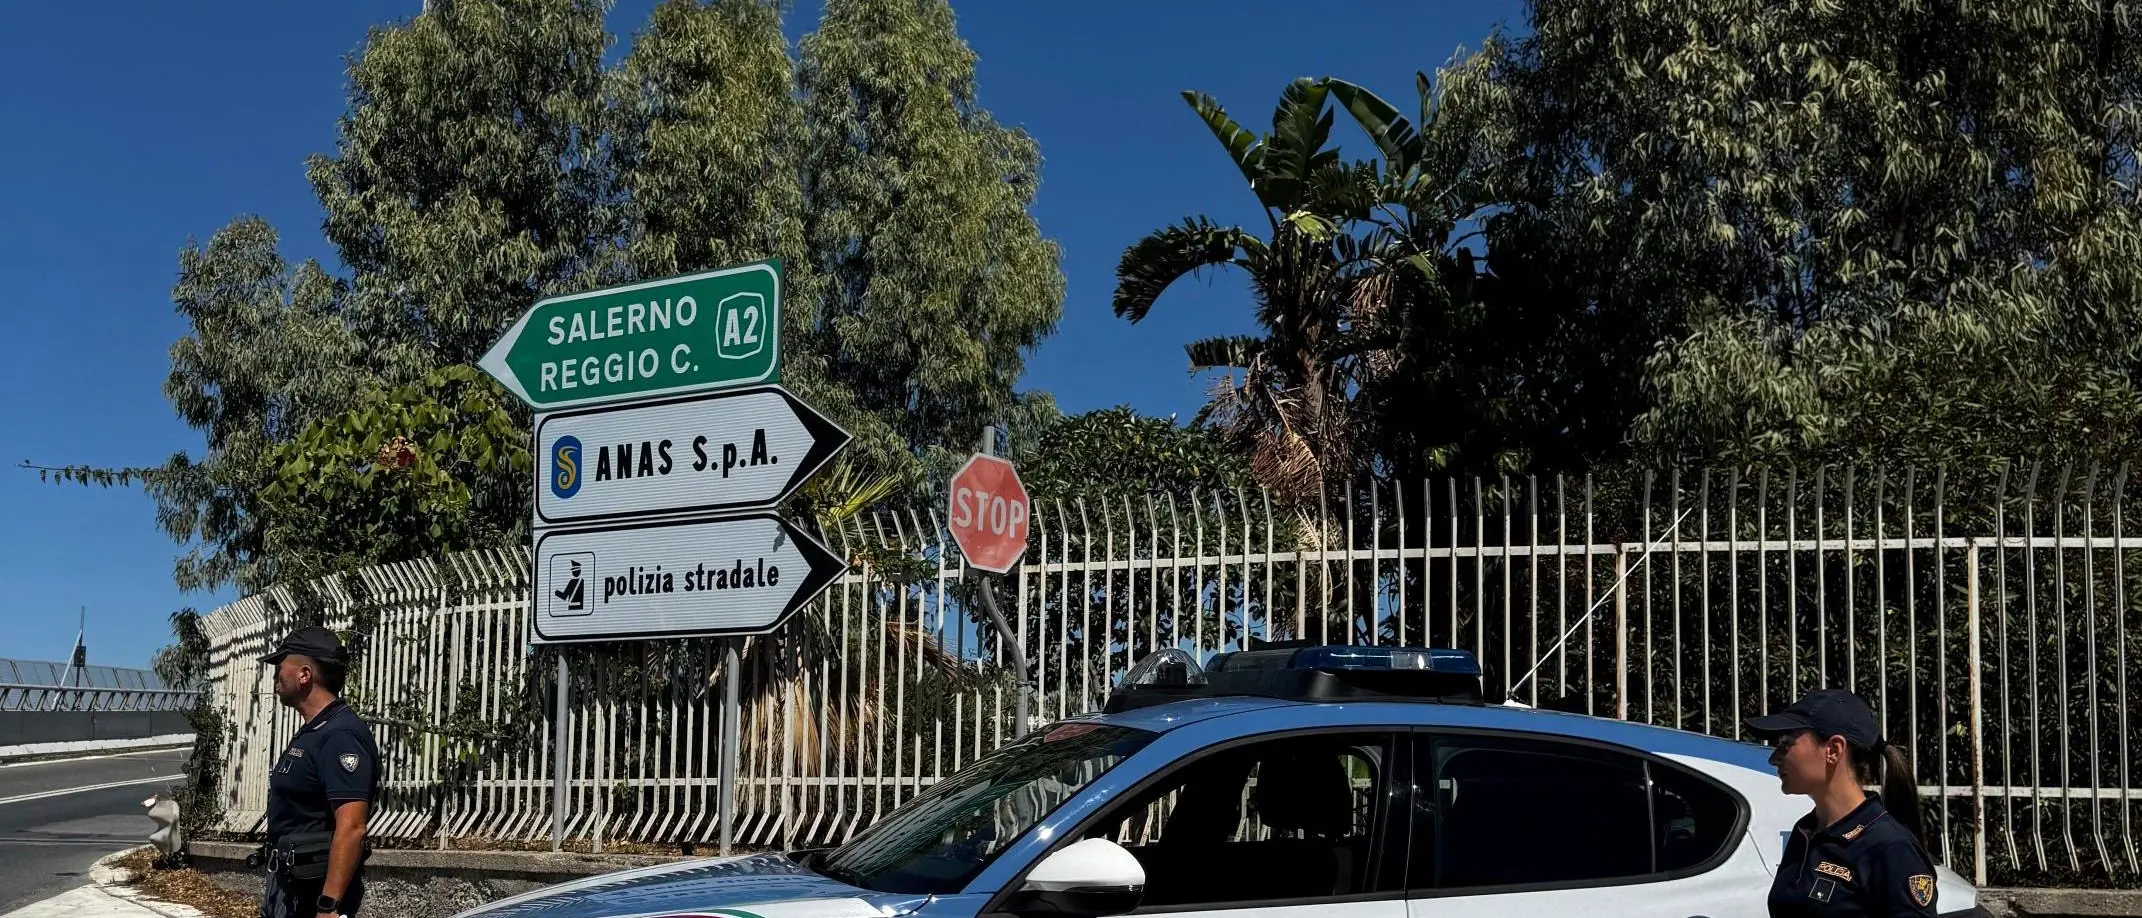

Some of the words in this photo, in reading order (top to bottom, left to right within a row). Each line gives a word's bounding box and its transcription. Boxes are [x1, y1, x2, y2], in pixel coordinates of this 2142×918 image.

[547, 295, 697, 345] SALERNO
[723, 305, 759, 347] A2
[540, 348, 659, 392] REGGIO
[670, 343, 699, 374] C.
[595, 439, 673, 482] ANAS
[692, 428, 778, 478] S.p.A.
[956, 487, 1024, 538] STOP
[604, 565, 674, 603] polizia
[684, 558, 779, 592] stradale
